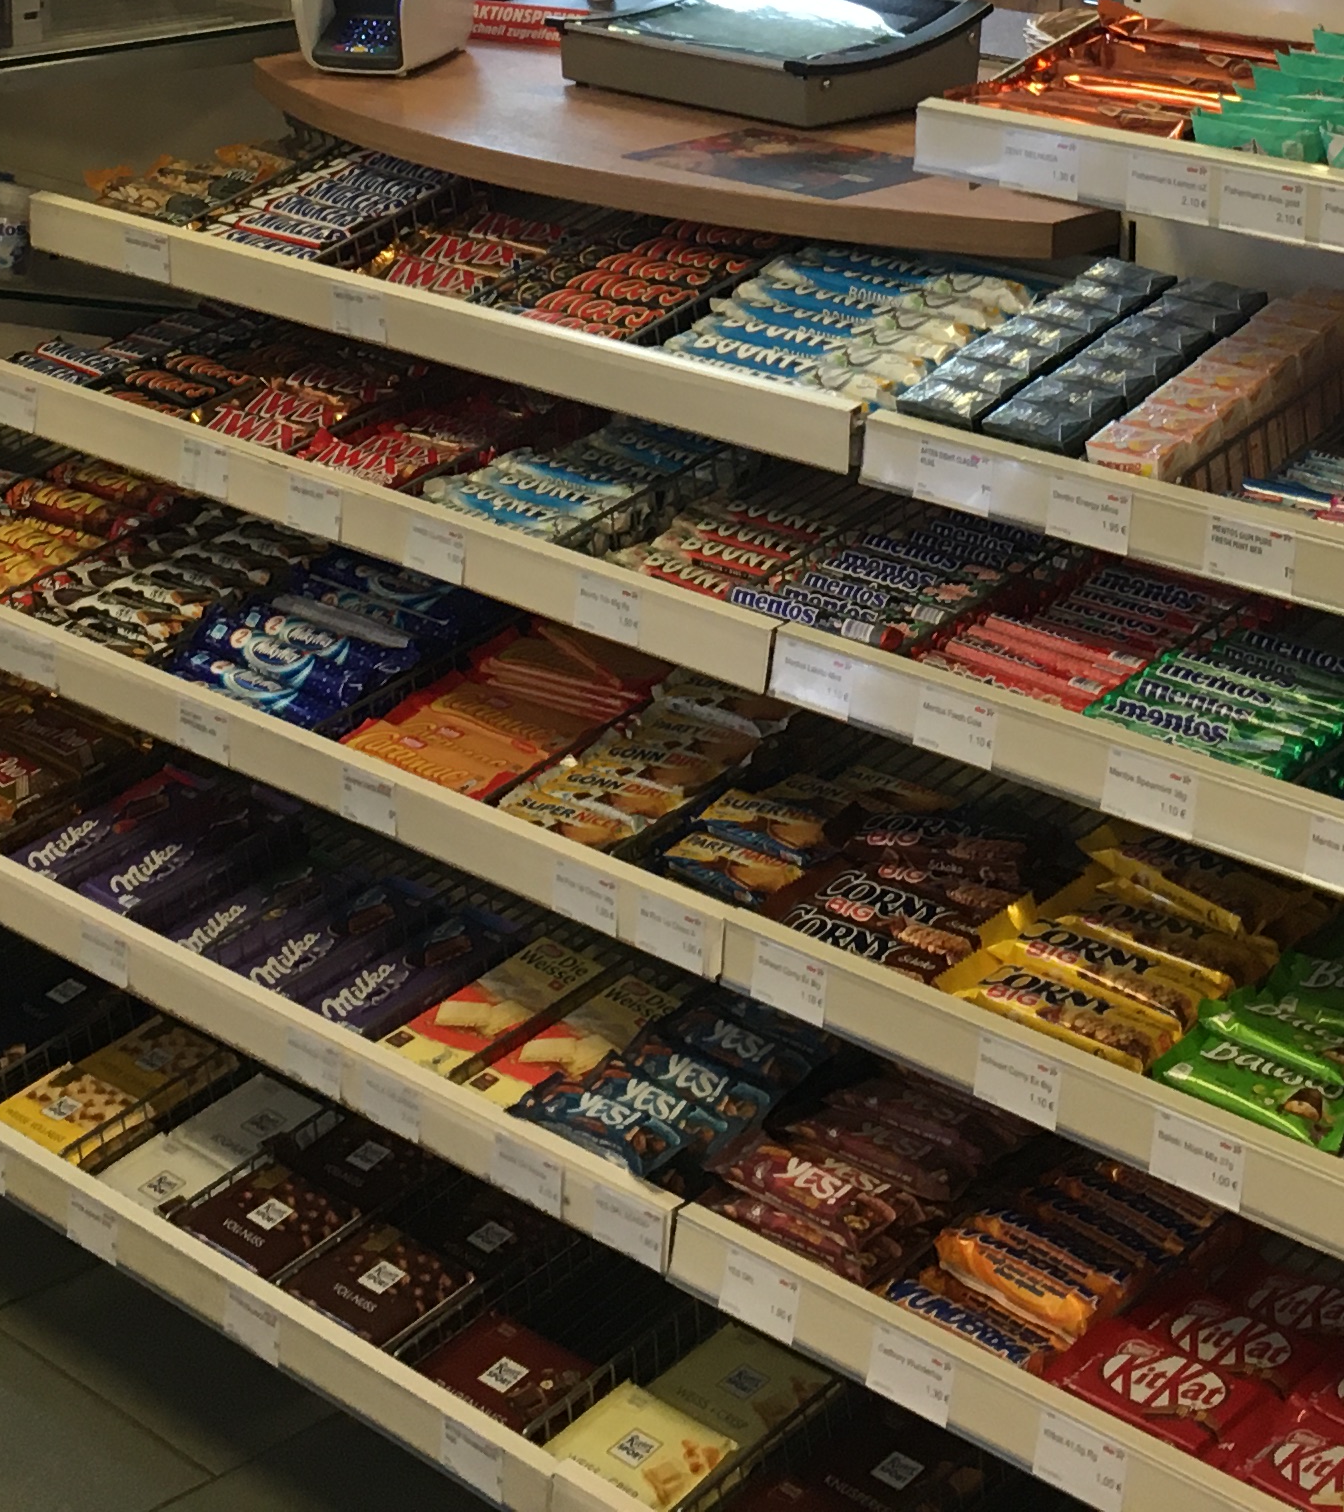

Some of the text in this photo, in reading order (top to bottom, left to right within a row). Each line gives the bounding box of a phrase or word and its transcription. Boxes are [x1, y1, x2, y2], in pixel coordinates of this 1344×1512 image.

[732, 586, 818, 625] mentos
[803, 571, 887, 609] mentos
[28, 818, 99, 869] Milka
[110, 841, 182, 894] Milka
[664, 1053, 727, 1099] YES!
[1103, 1352, 1227, 1409] KitKat
